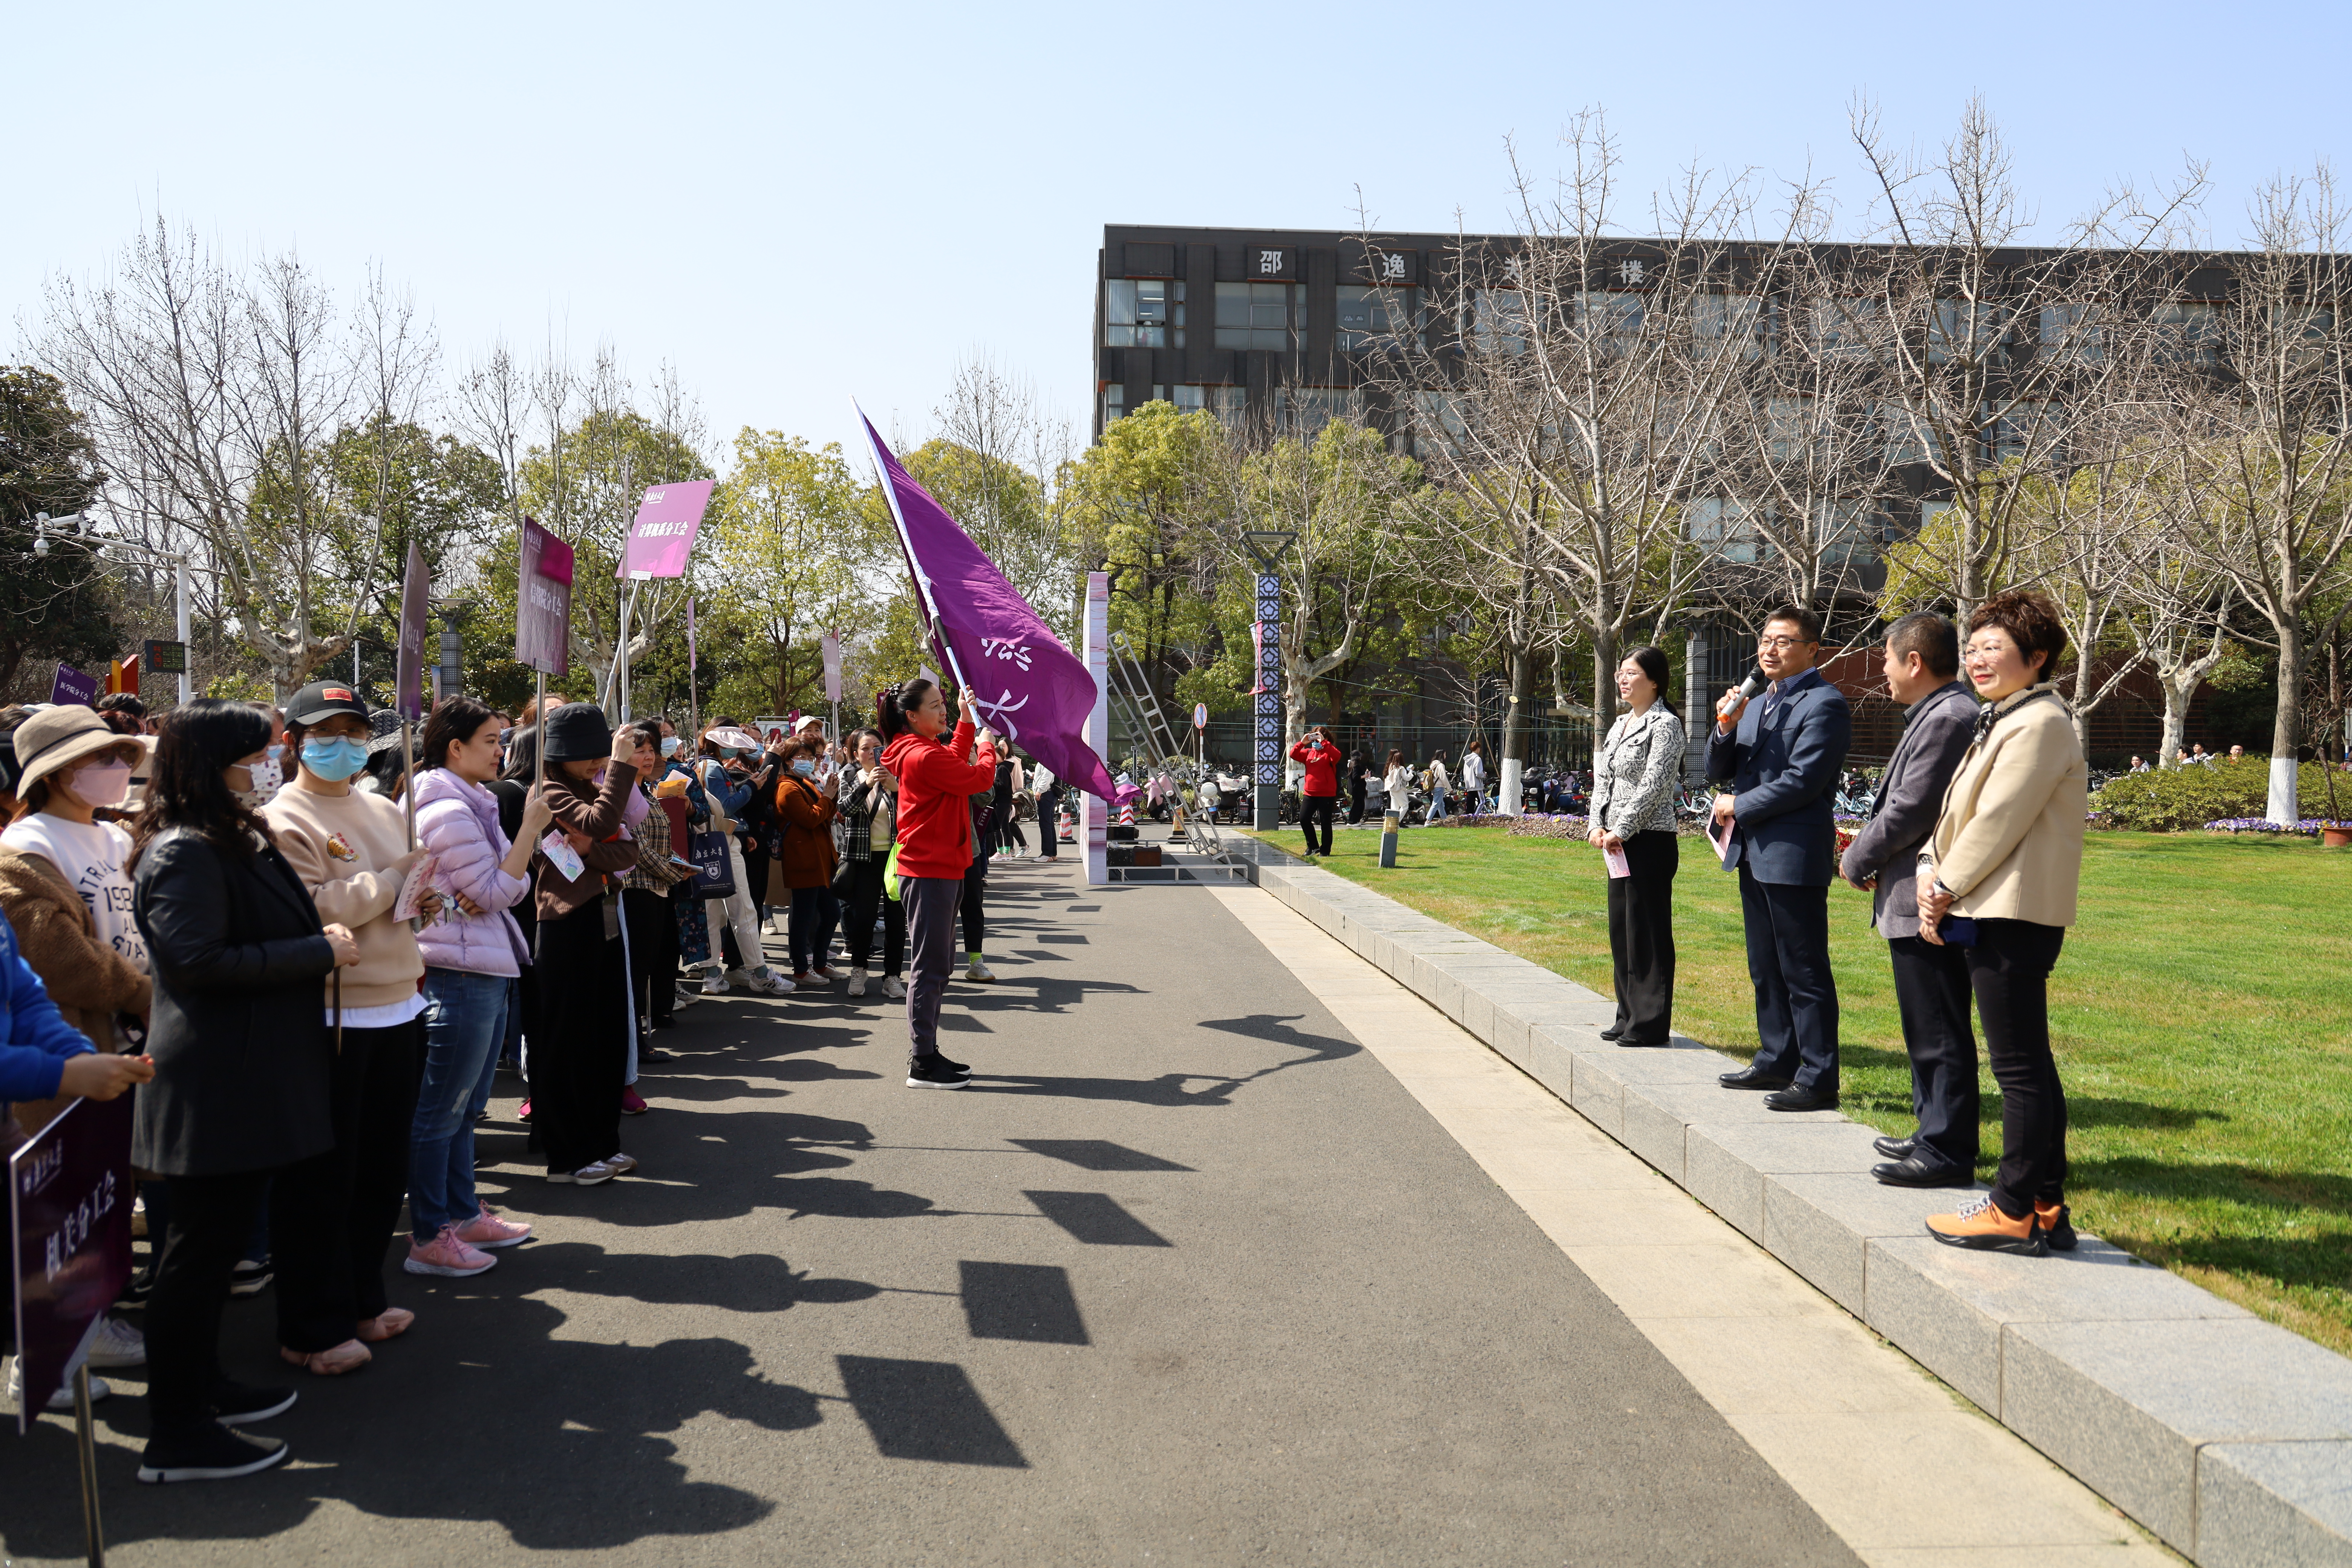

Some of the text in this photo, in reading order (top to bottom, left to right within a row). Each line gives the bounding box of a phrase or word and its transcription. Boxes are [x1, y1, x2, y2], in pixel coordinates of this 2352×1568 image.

[638, 521, 689, 538] 计算机系分工会
[60, 681, 89, 701] 医学院分工会
[77, 860, 117, 914] NTRAL
[112, 935, 146, 959] STA
